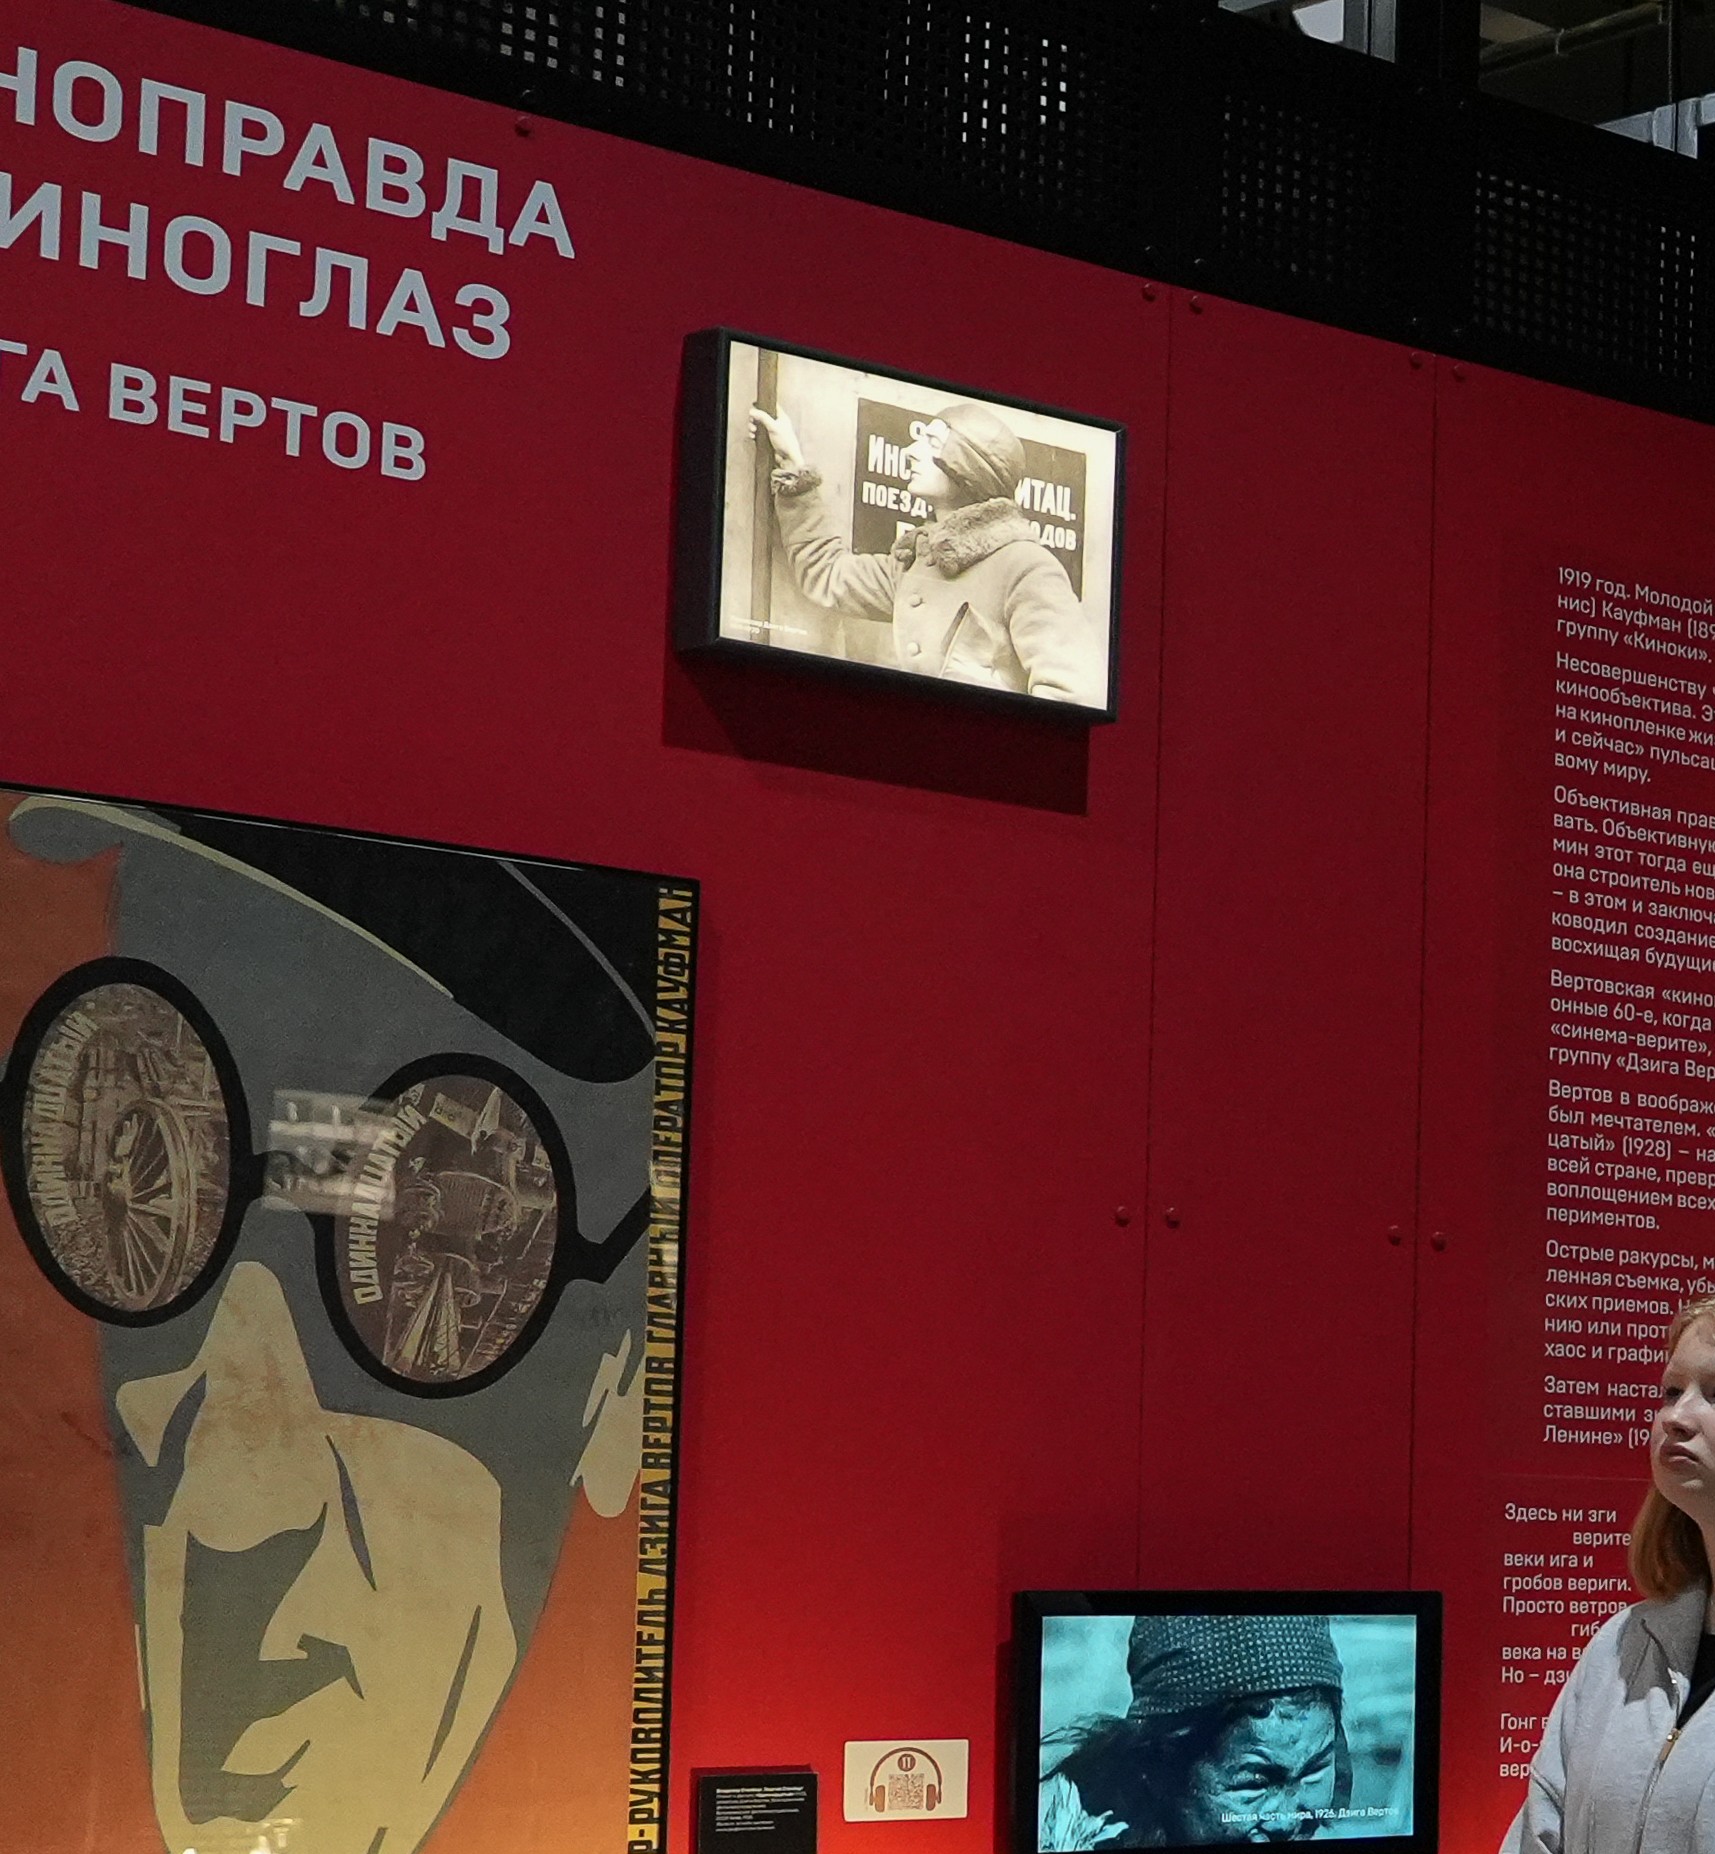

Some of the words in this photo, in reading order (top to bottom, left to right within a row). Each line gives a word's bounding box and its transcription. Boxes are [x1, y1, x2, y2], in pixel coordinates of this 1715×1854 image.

[109, 362, 427, 482] ВЕРТОВ
[1559, 566, 1591, 588] 1919
[1595, 578, 1630, 600] год.
[1635, 583, 1712, 616] Молодой
[1602, 599, 1681, 633] Кауфман
[1557, 618, 1618, 646] группу
[1623, 630, 1712, 663] «Киноки».
[656, 886, 694, 1036] КАУФМАН
[1550, 968, 1654, 999] Вертовская
[1549, 1046, 1611, 1069] группу
[1616, 1052, 1678, 1074] «Дзига
[1545, 1238, 1614, 1262] Острые
[1618, 1249, 1698, 1270] ракурсы,
[642, 1357, 678, 1471] ВЕРТОВ
[1504, 1503, 1558, 1522] Здесь
[1562, 1508, 1583, 1522] ни
[1588, 1508, 1617, 1523] зги
[1573, 1532, 1632, 1547] верите
[1504, 1553, 1544, 1567] веки
[1549, 1554, 1578, 1567] ига
[1583, 1555, 1593, 1567] и
[1503, 1574, 1563, 1592] гробов
[1568, 1577, 1632, 1592] вериги.
[1503, 1596, 1564, 1616] Просто
[1502, 1646, 1541, 1660] века
[1547, 1647, 1567, 1660] на
[1501, 1666, 1524, 1683] Но
[1500, 1713, 1537, 1730] Гонг
